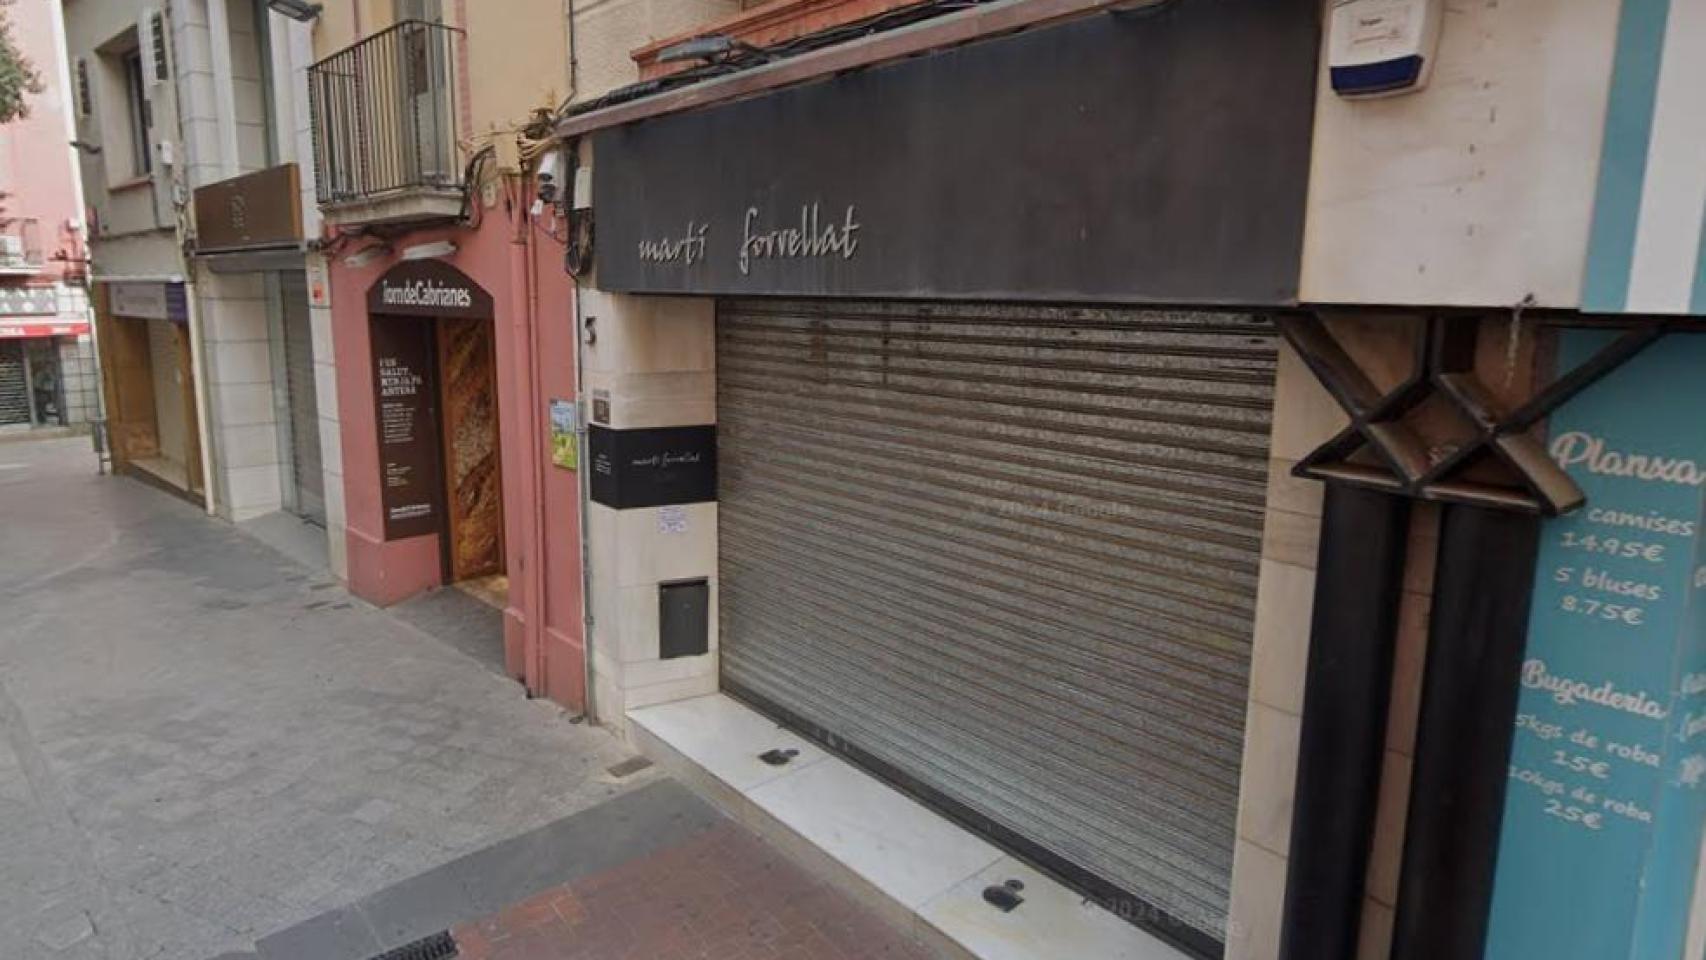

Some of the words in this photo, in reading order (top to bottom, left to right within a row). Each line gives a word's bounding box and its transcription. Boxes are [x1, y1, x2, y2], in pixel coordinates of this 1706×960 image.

[638, 221, 708, 264] martí
[1551, 431, 1706, 486] Planxa
[1588, 508, 1694, 536] camises
[1561, 531, 1664, 562] 14.95€
[1554, 566, 1572, 583] 5
[1583, 567, 1661, 600] bluses
[1562, 594, 1643, 625] 8.75€
[1553, 749, 1610, 779] 15€
[1571, 728, 1598, 749] de
[1606, 742, 1660, 768] roba
[1544, 798, 1602, 829] 25€
[1571, 786, 1596, 805] de
[1603, 798, 1653, 822] roba
